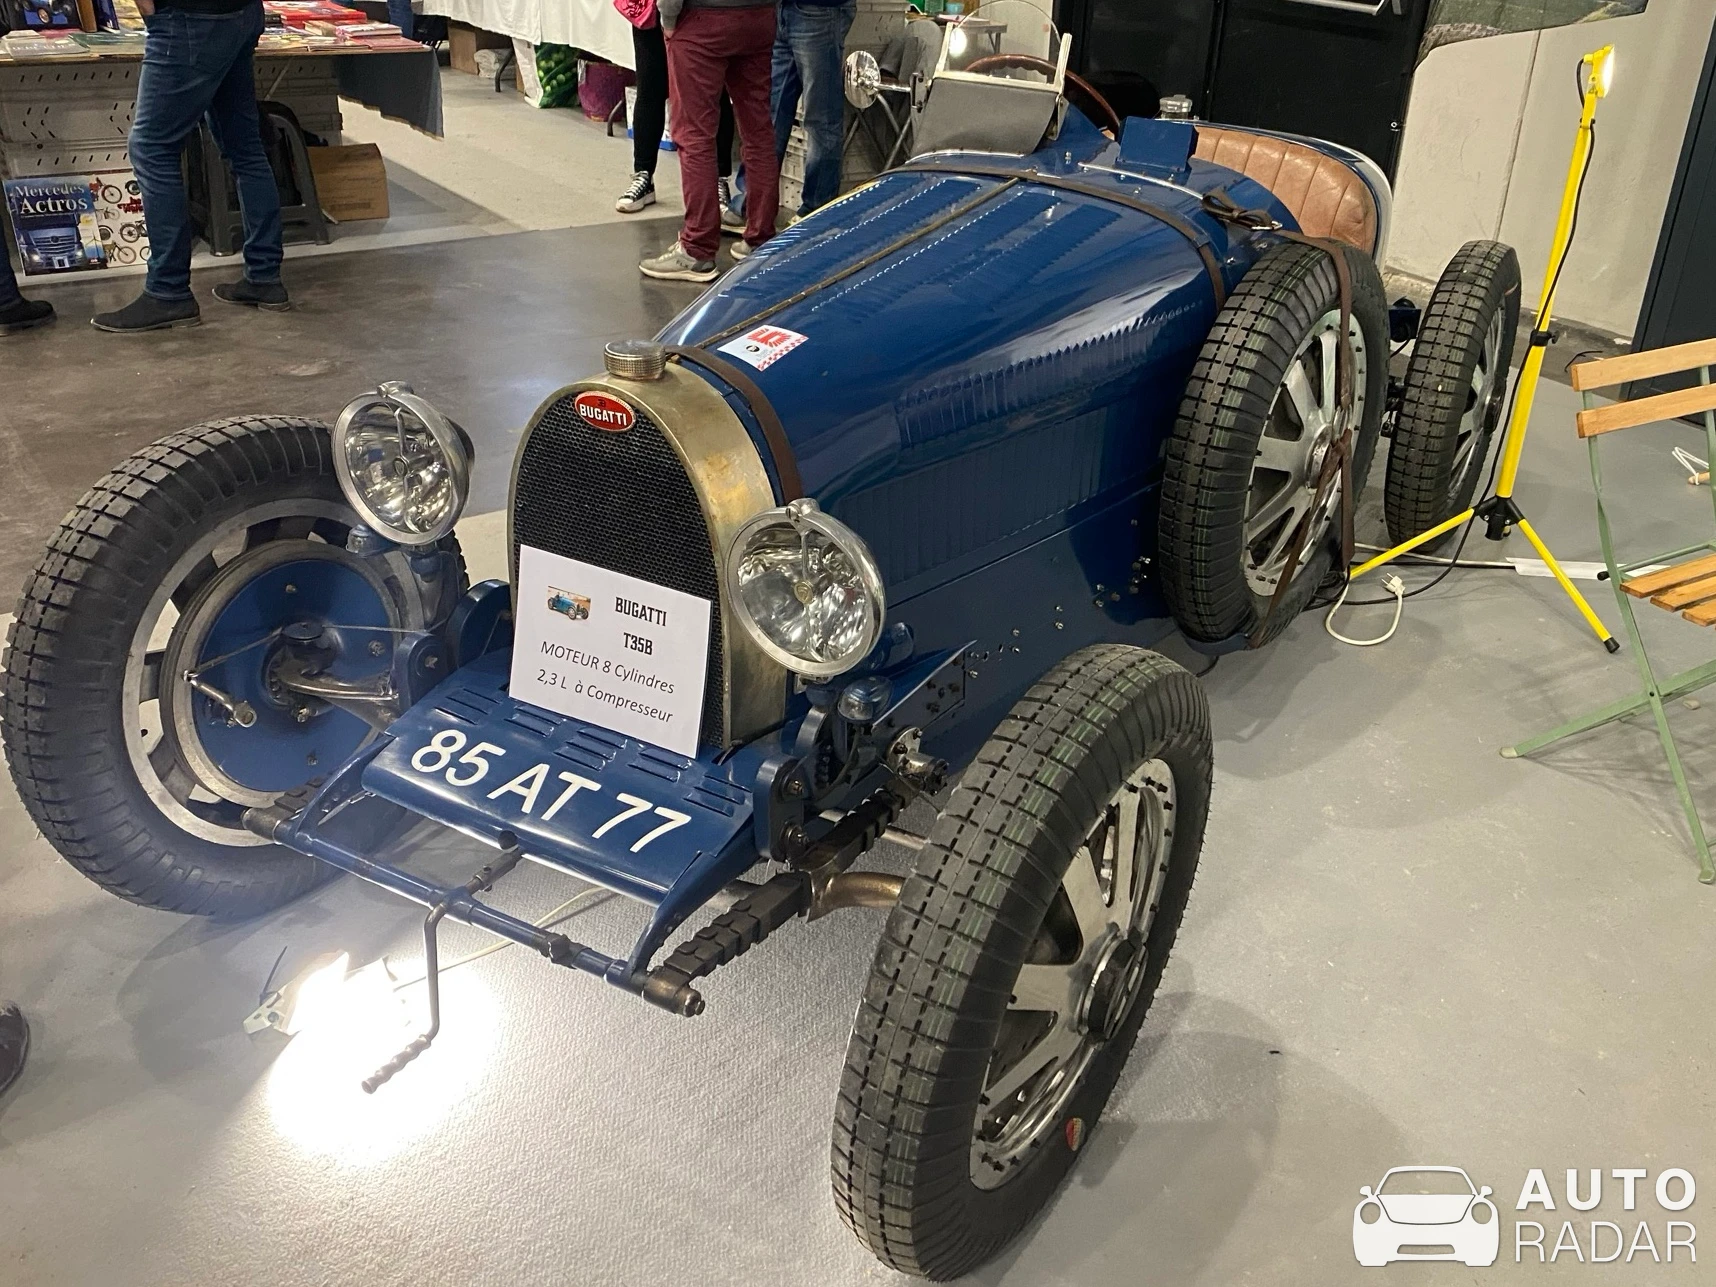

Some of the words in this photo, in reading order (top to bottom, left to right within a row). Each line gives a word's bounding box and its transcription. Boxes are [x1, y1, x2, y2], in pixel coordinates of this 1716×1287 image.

[14, 183, 85, 198] Mercedes
[19, 196, 88, 214] Actros
[579, 403, 627, 426] BUGATTI
[615, 596, 667, 627] BUGATTI
[623, 632, 653, 656] T35B
[540, 641, 600, 670] MOTEUR
[602, 660, 611, 674] 8
[614, 664, 675, 694] Cylindres
[537, 669, 558, 685] 2,3
[560, 676, 567, 690] L
[574, 680, 583, 694] à
[587, 685, 674, 723] Compresseur
[411, 729, 507, 787] 85
[486, 762, 602, 821] AT
[591, 792, 692, 853] 77
